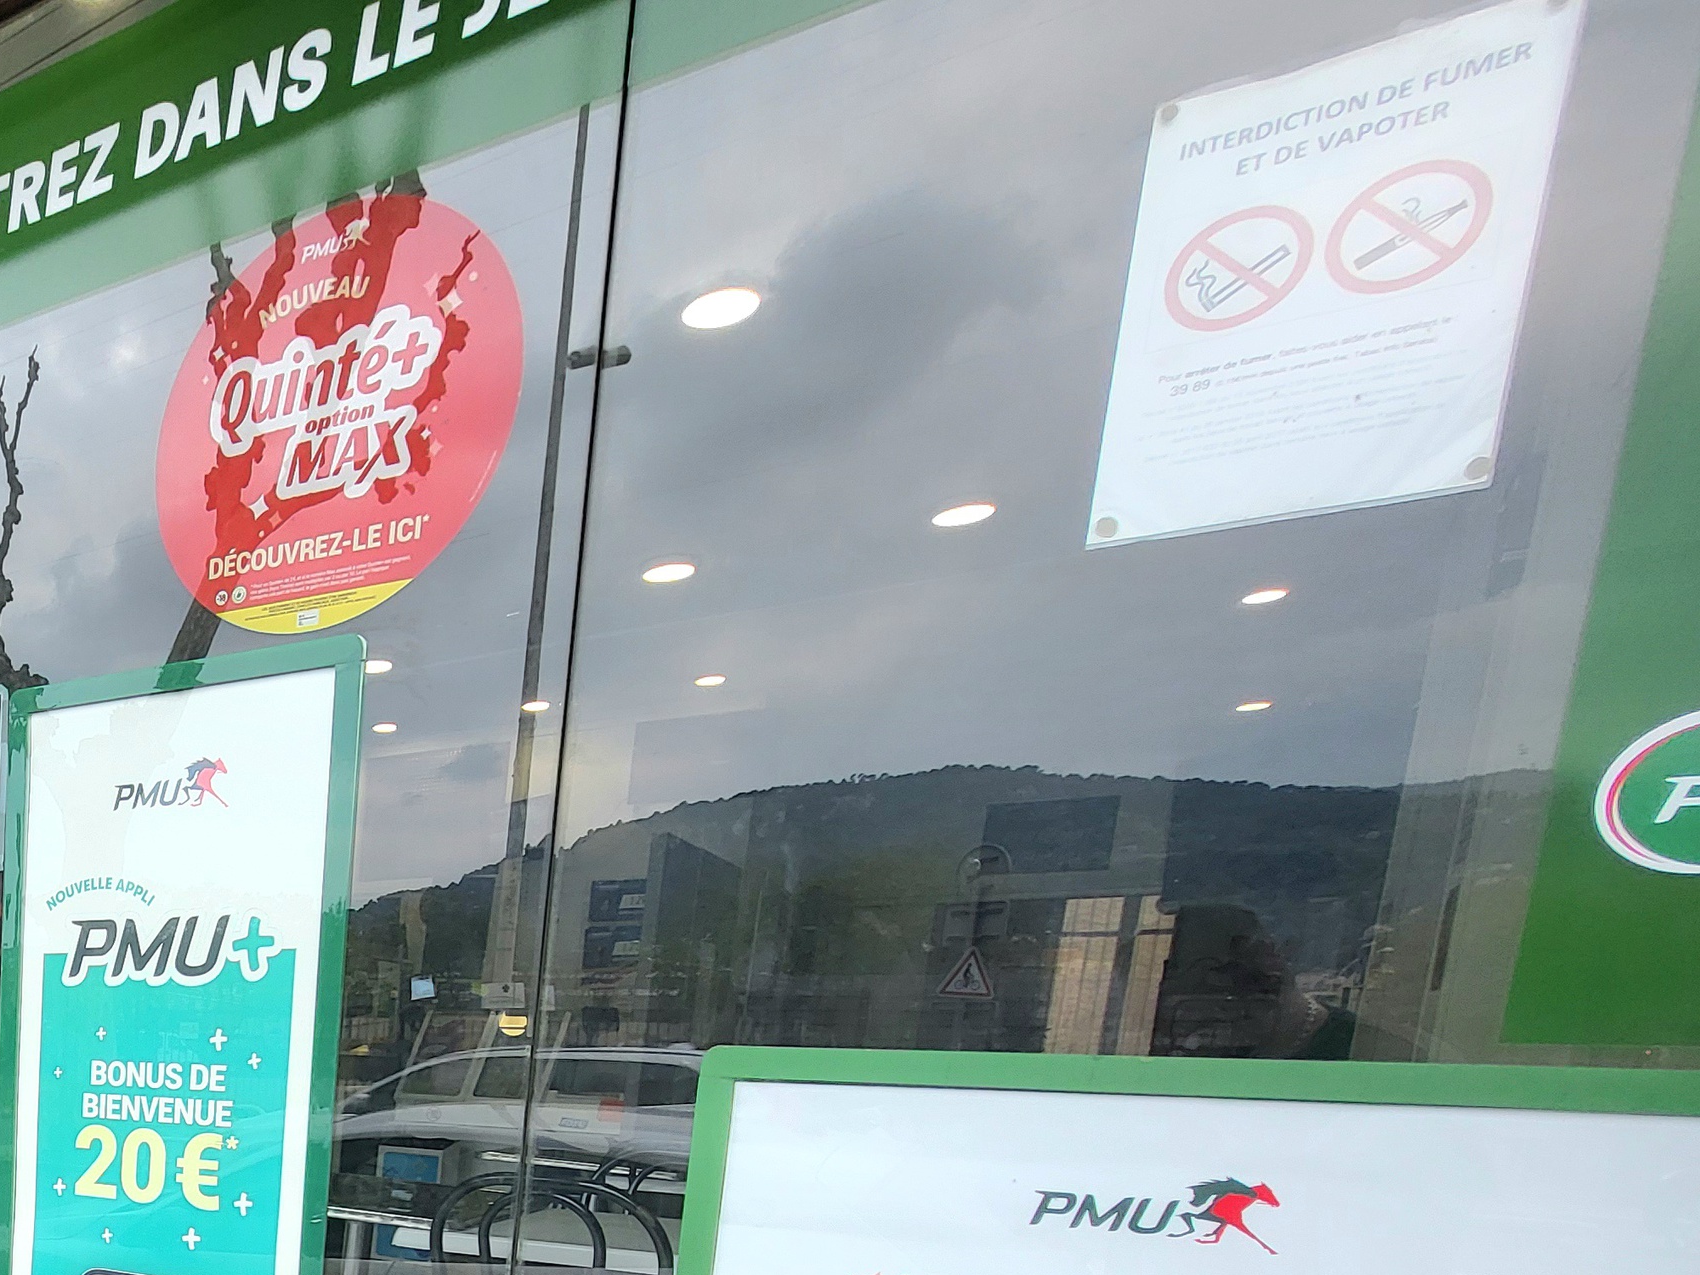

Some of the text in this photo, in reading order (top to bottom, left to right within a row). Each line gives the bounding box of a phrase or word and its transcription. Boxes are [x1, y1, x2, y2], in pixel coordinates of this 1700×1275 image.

[134, 27, 333, 180] DANS
[350, 0, 442, 87] LE
[1179, 41, 1534, 162] INTERDICTION DE FUMER
[1235, 101, 1451, 177] ET DE VAPOTER
[301, 234, 346, 265] PMU
[257, 275, 370, 330] NOUVEAU
[221, 318, 429, 446] Quinté+
[1158, 372, 1181, 384] Pour
[1222, 360, 1238, 370] de
[1169, 378, 1211, 398] 39 89
[304, 405, 375, 436] option
[286, 415, 409, 487] MAX
[208, 521, 382, 581] DÉCOUVREZ-LE
[113, 778, 183, 812] PMU
[45, 877, 156, 912] NOUVELLE APPLI
[68, 914, 275, 978] PMU+
[90, 1059, 228, 1092] BONUS DE
[82, 1092, 234, 1128] BIENVENUE
[1027, 1190, 1181, 1237] PMU
